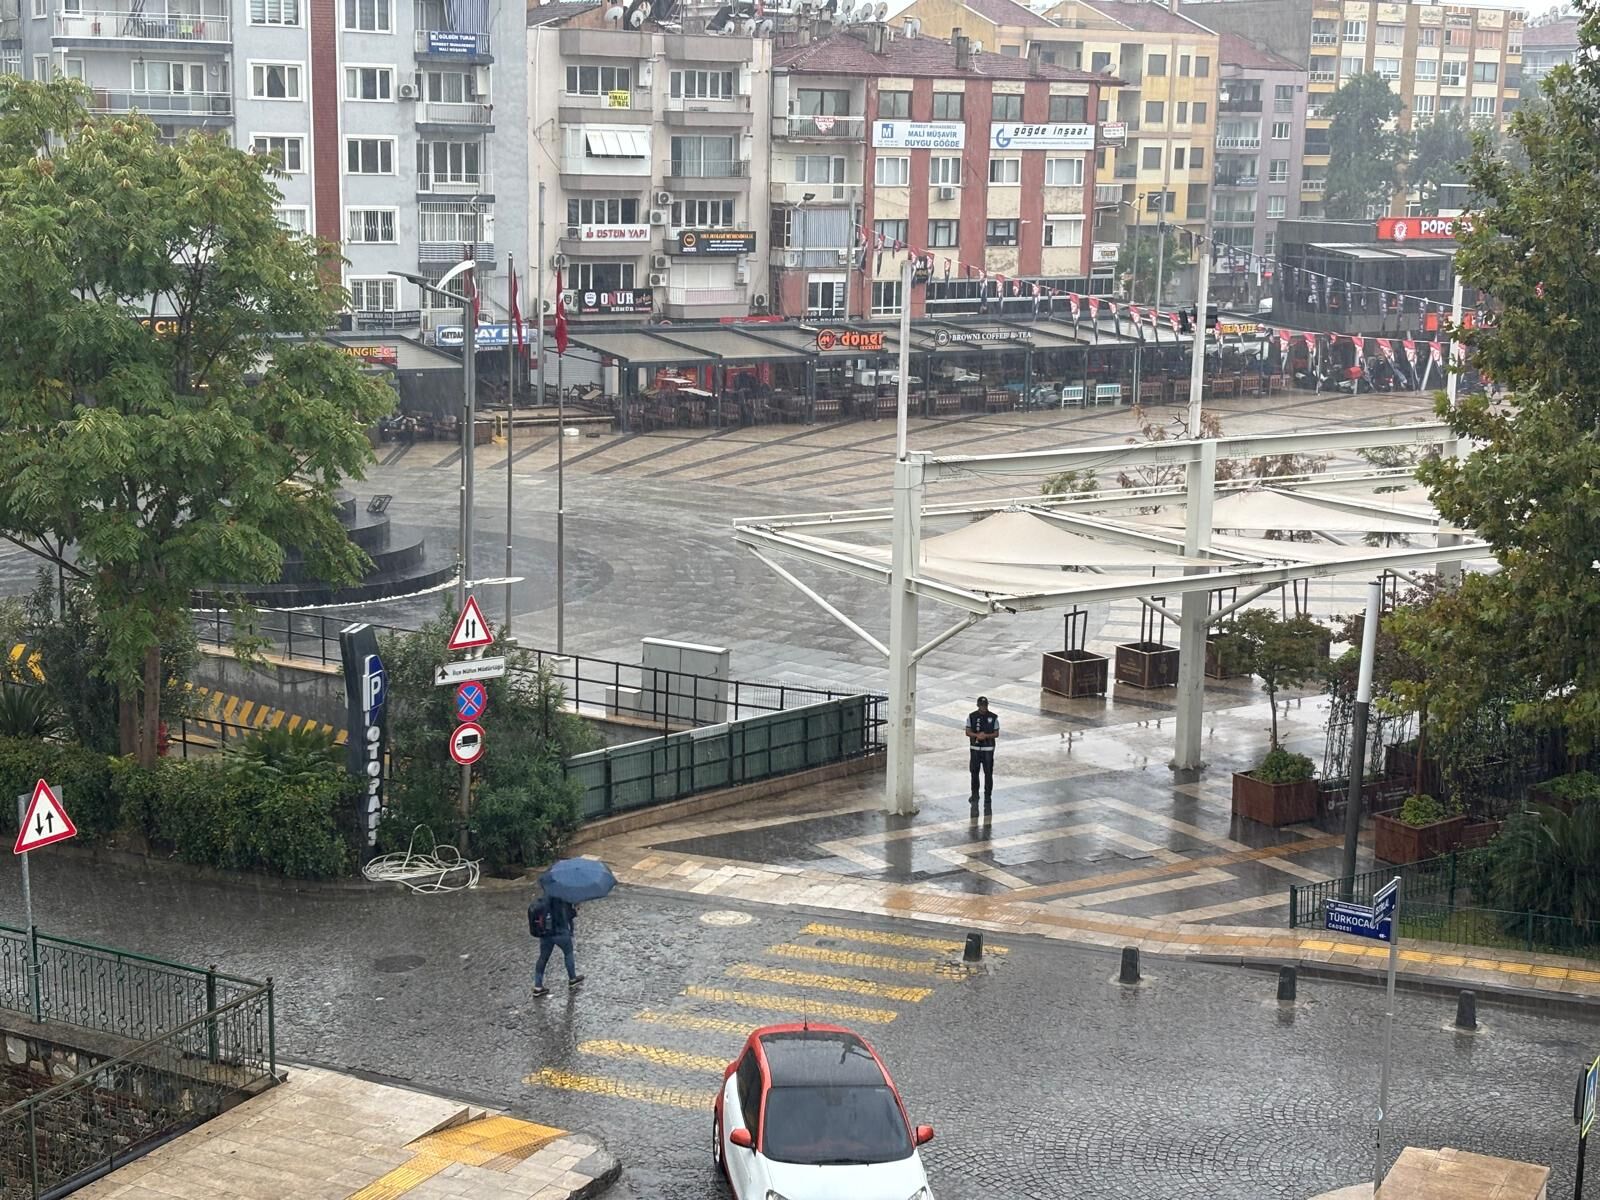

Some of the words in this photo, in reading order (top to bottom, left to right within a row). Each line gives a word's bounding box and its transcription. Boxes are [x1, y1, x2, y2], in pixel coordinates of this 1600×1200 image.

[908, 130, 925, 138] MALİ
[926, 131, 957, 139] MÜŞAVİR
[904, 139, 932, 147] DUYGU
[628, 229, 648, 239] YAPI
[600, 292, 635, 306] ONUR
[841, 330, 884, 346] döner
[1019, 331, 1032, 339] TEA
[370, 675, 382, 707] P
